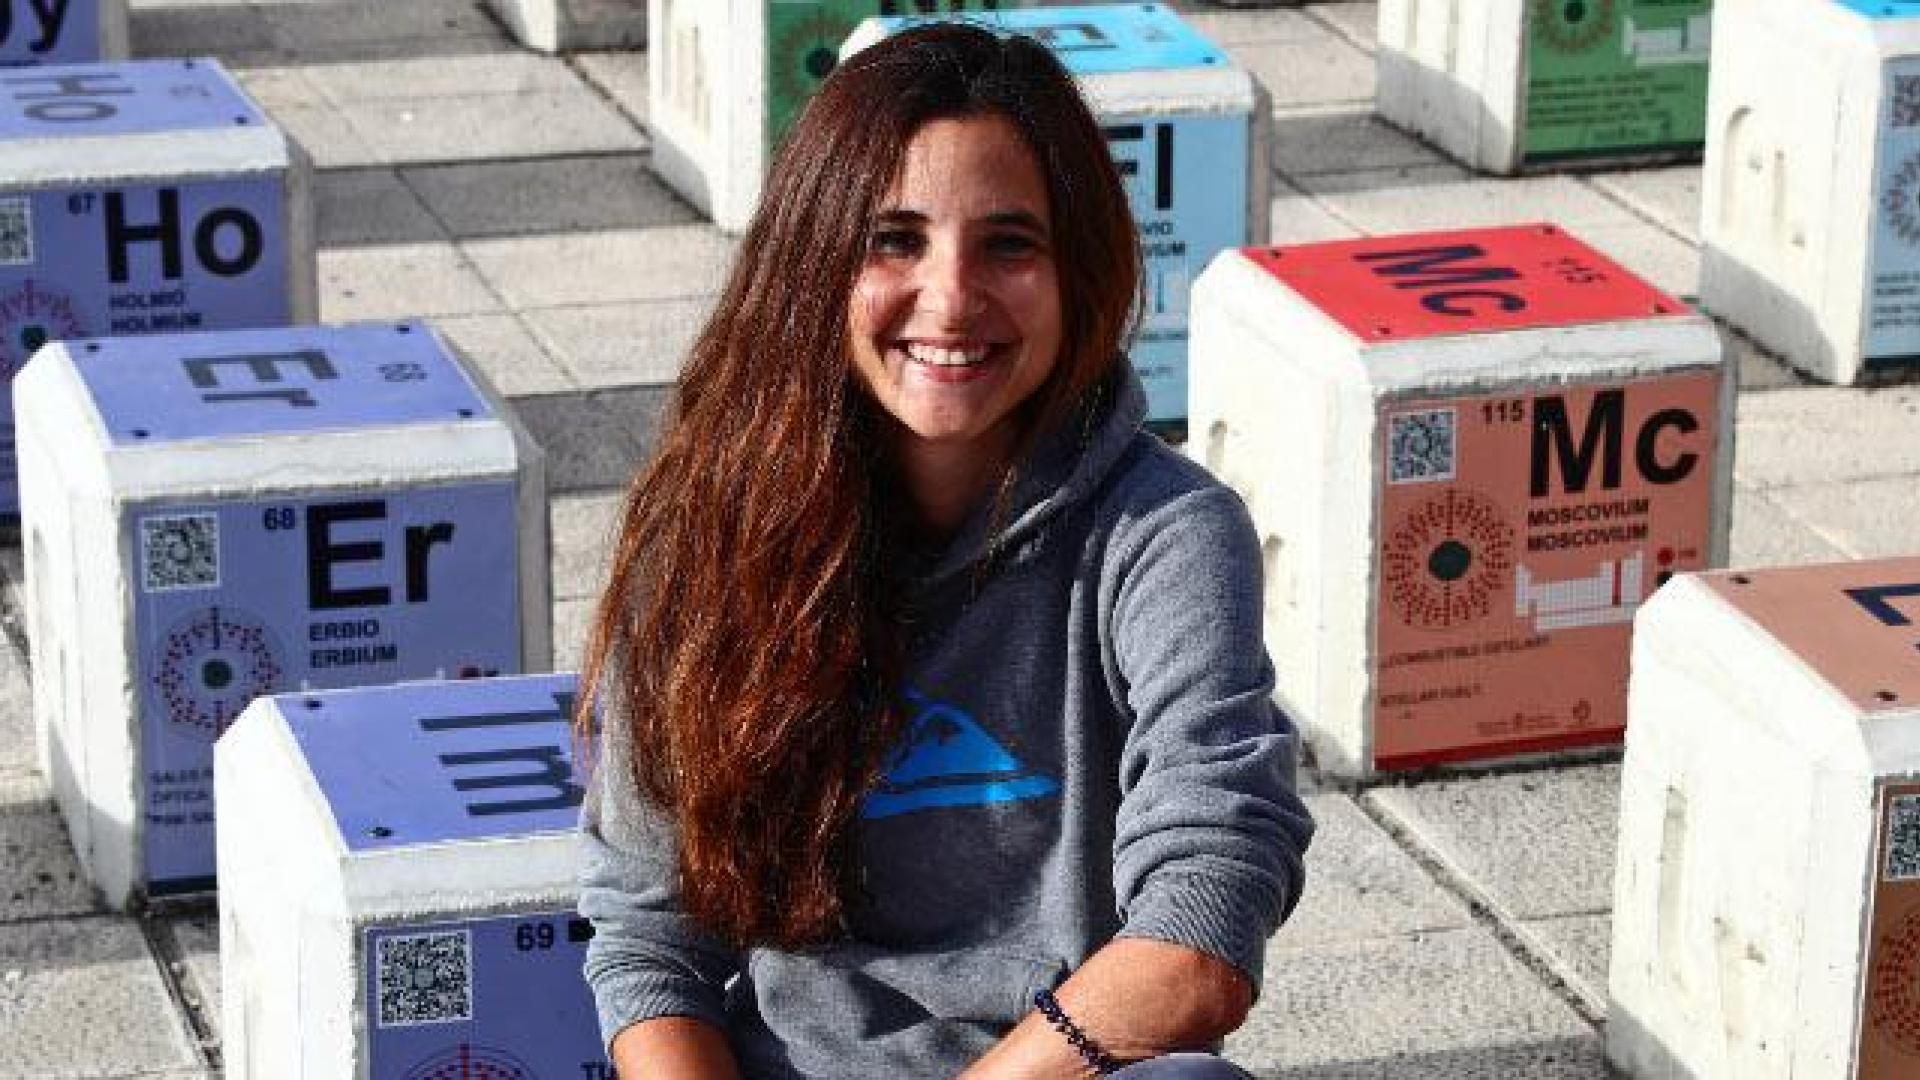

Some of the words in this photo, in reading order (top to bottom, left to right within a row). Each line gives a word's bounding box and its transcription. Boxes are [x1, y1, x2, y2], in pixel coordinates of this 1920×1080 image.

[0, 0, 68, 54] y
[2, 73, 135, 123] Ho
[67, 191, 96, 215] 67
[104, 188, 264, 283] Ho
[110, 289, 187, 311] HOLMIO
[1353, 244, 1526, 316] Mc
[111, 312, 202, 335] HOLMIUM
[181, 348, 338, 408] Er
[1481, 400, 1524, 424] 115
[1530, 388, 1699, 497] Mc
[1527, 499, 1649, 527] MOSCOVIUM
[1527, 523, 1649, 552] MOSCOVIUM
[264, 507, 297, 531] 68
[306, 500, 455, 611] Er
[309, 618, 381, 642] ERBIO
[310, 643, 398, 669] ERBIUM
[418, 692, 588, 816] Tm
[516, 922, 555, 952] 69
